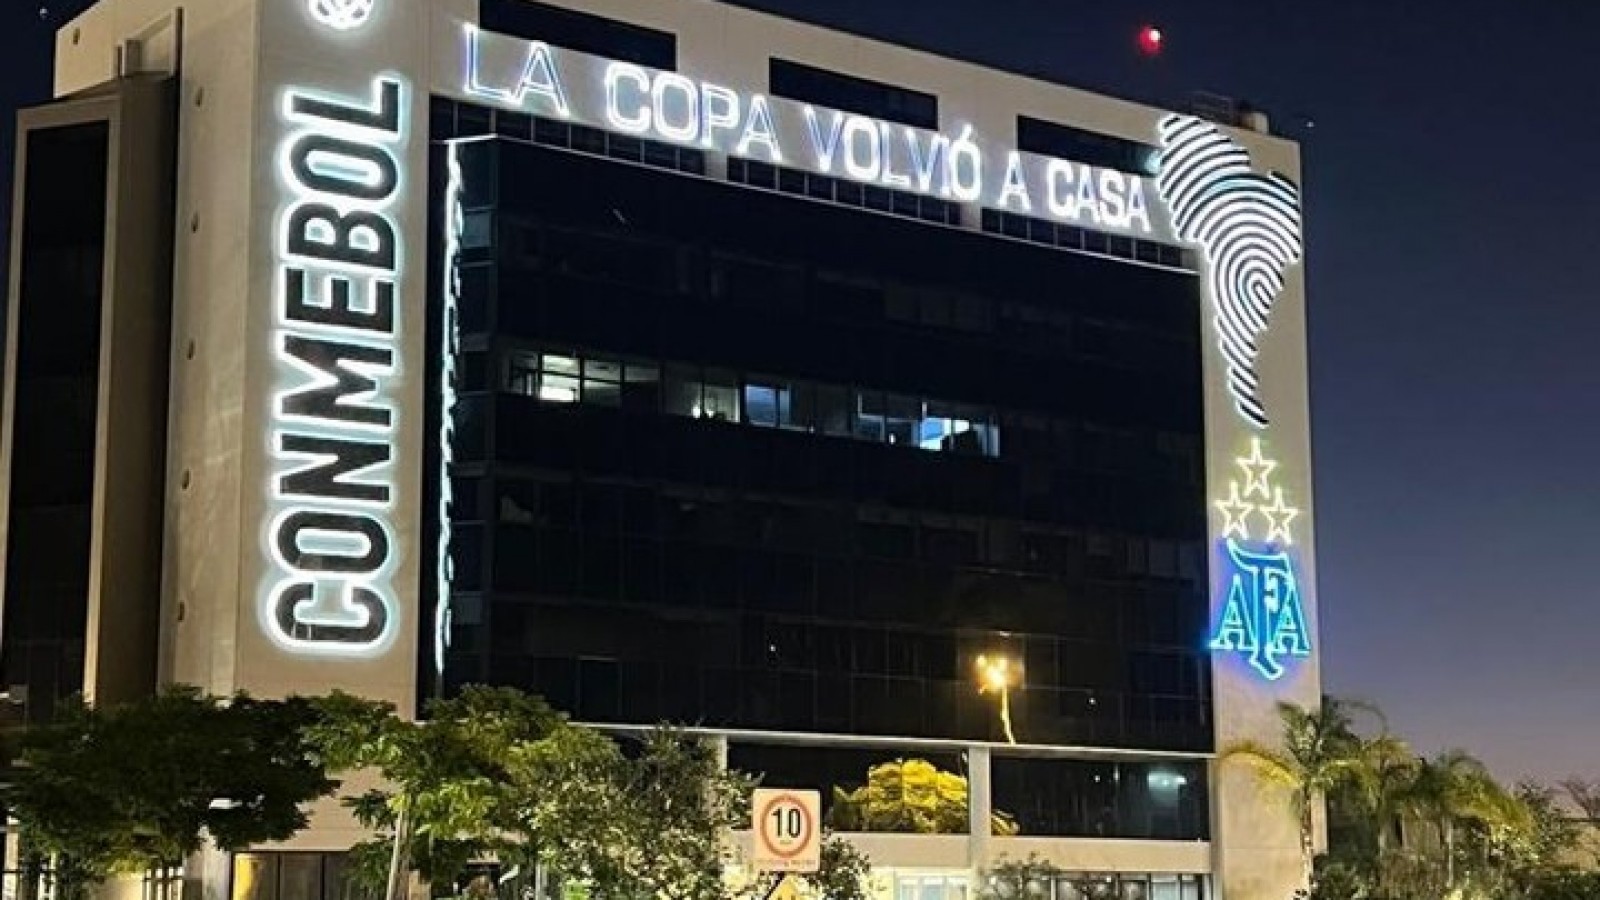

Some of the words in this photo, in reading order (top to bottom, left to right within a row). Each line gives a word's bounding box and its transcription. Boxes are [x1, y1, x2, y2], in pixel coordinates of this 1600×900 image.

[463, 22, 570, 118] LA
[604, 61, 783, 162] COPA
[803, 104, 981, 201] VOLVIÓ
[997, 150, 1032, 211] A
[1046, 158, 1151, 232] CASA
[272, 77, 403, 648] CONMEBOL
[1208, 537, 1311, 681] AFA
[771, 807, 801, 838] 10
